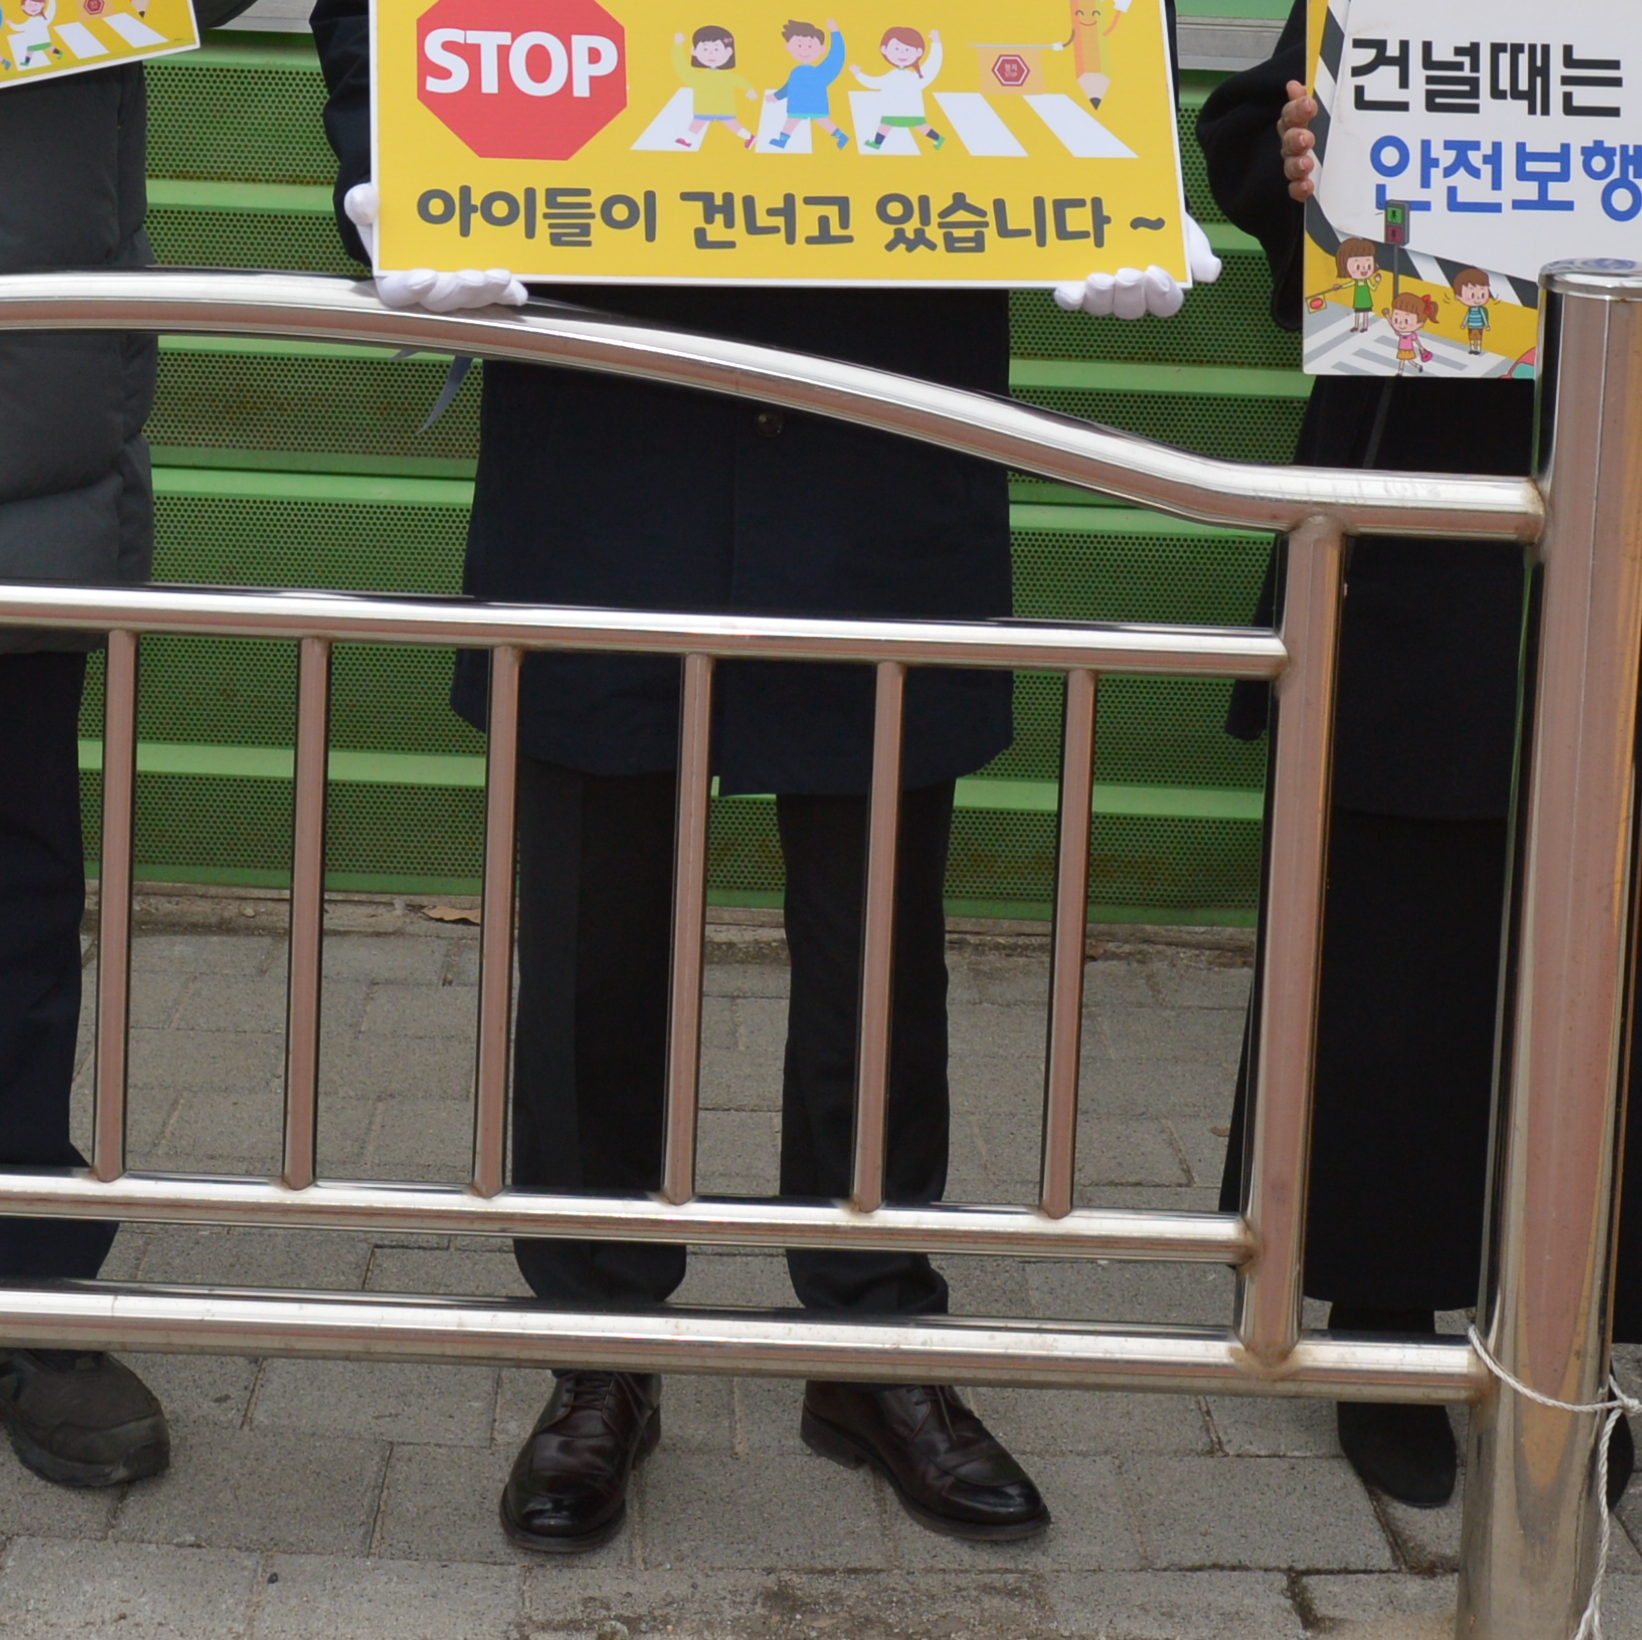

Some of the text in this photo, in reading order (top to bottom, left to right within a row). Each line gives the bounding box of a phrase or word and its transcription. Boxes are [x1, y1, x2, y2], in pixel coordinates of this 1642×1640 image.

[424, 28, 619, 99] STOP
[1350, 39, 1623, 118] 건널때는
[416, 185, 657, 247] 아이들이
[680, 191, 856, 249] 건너고
